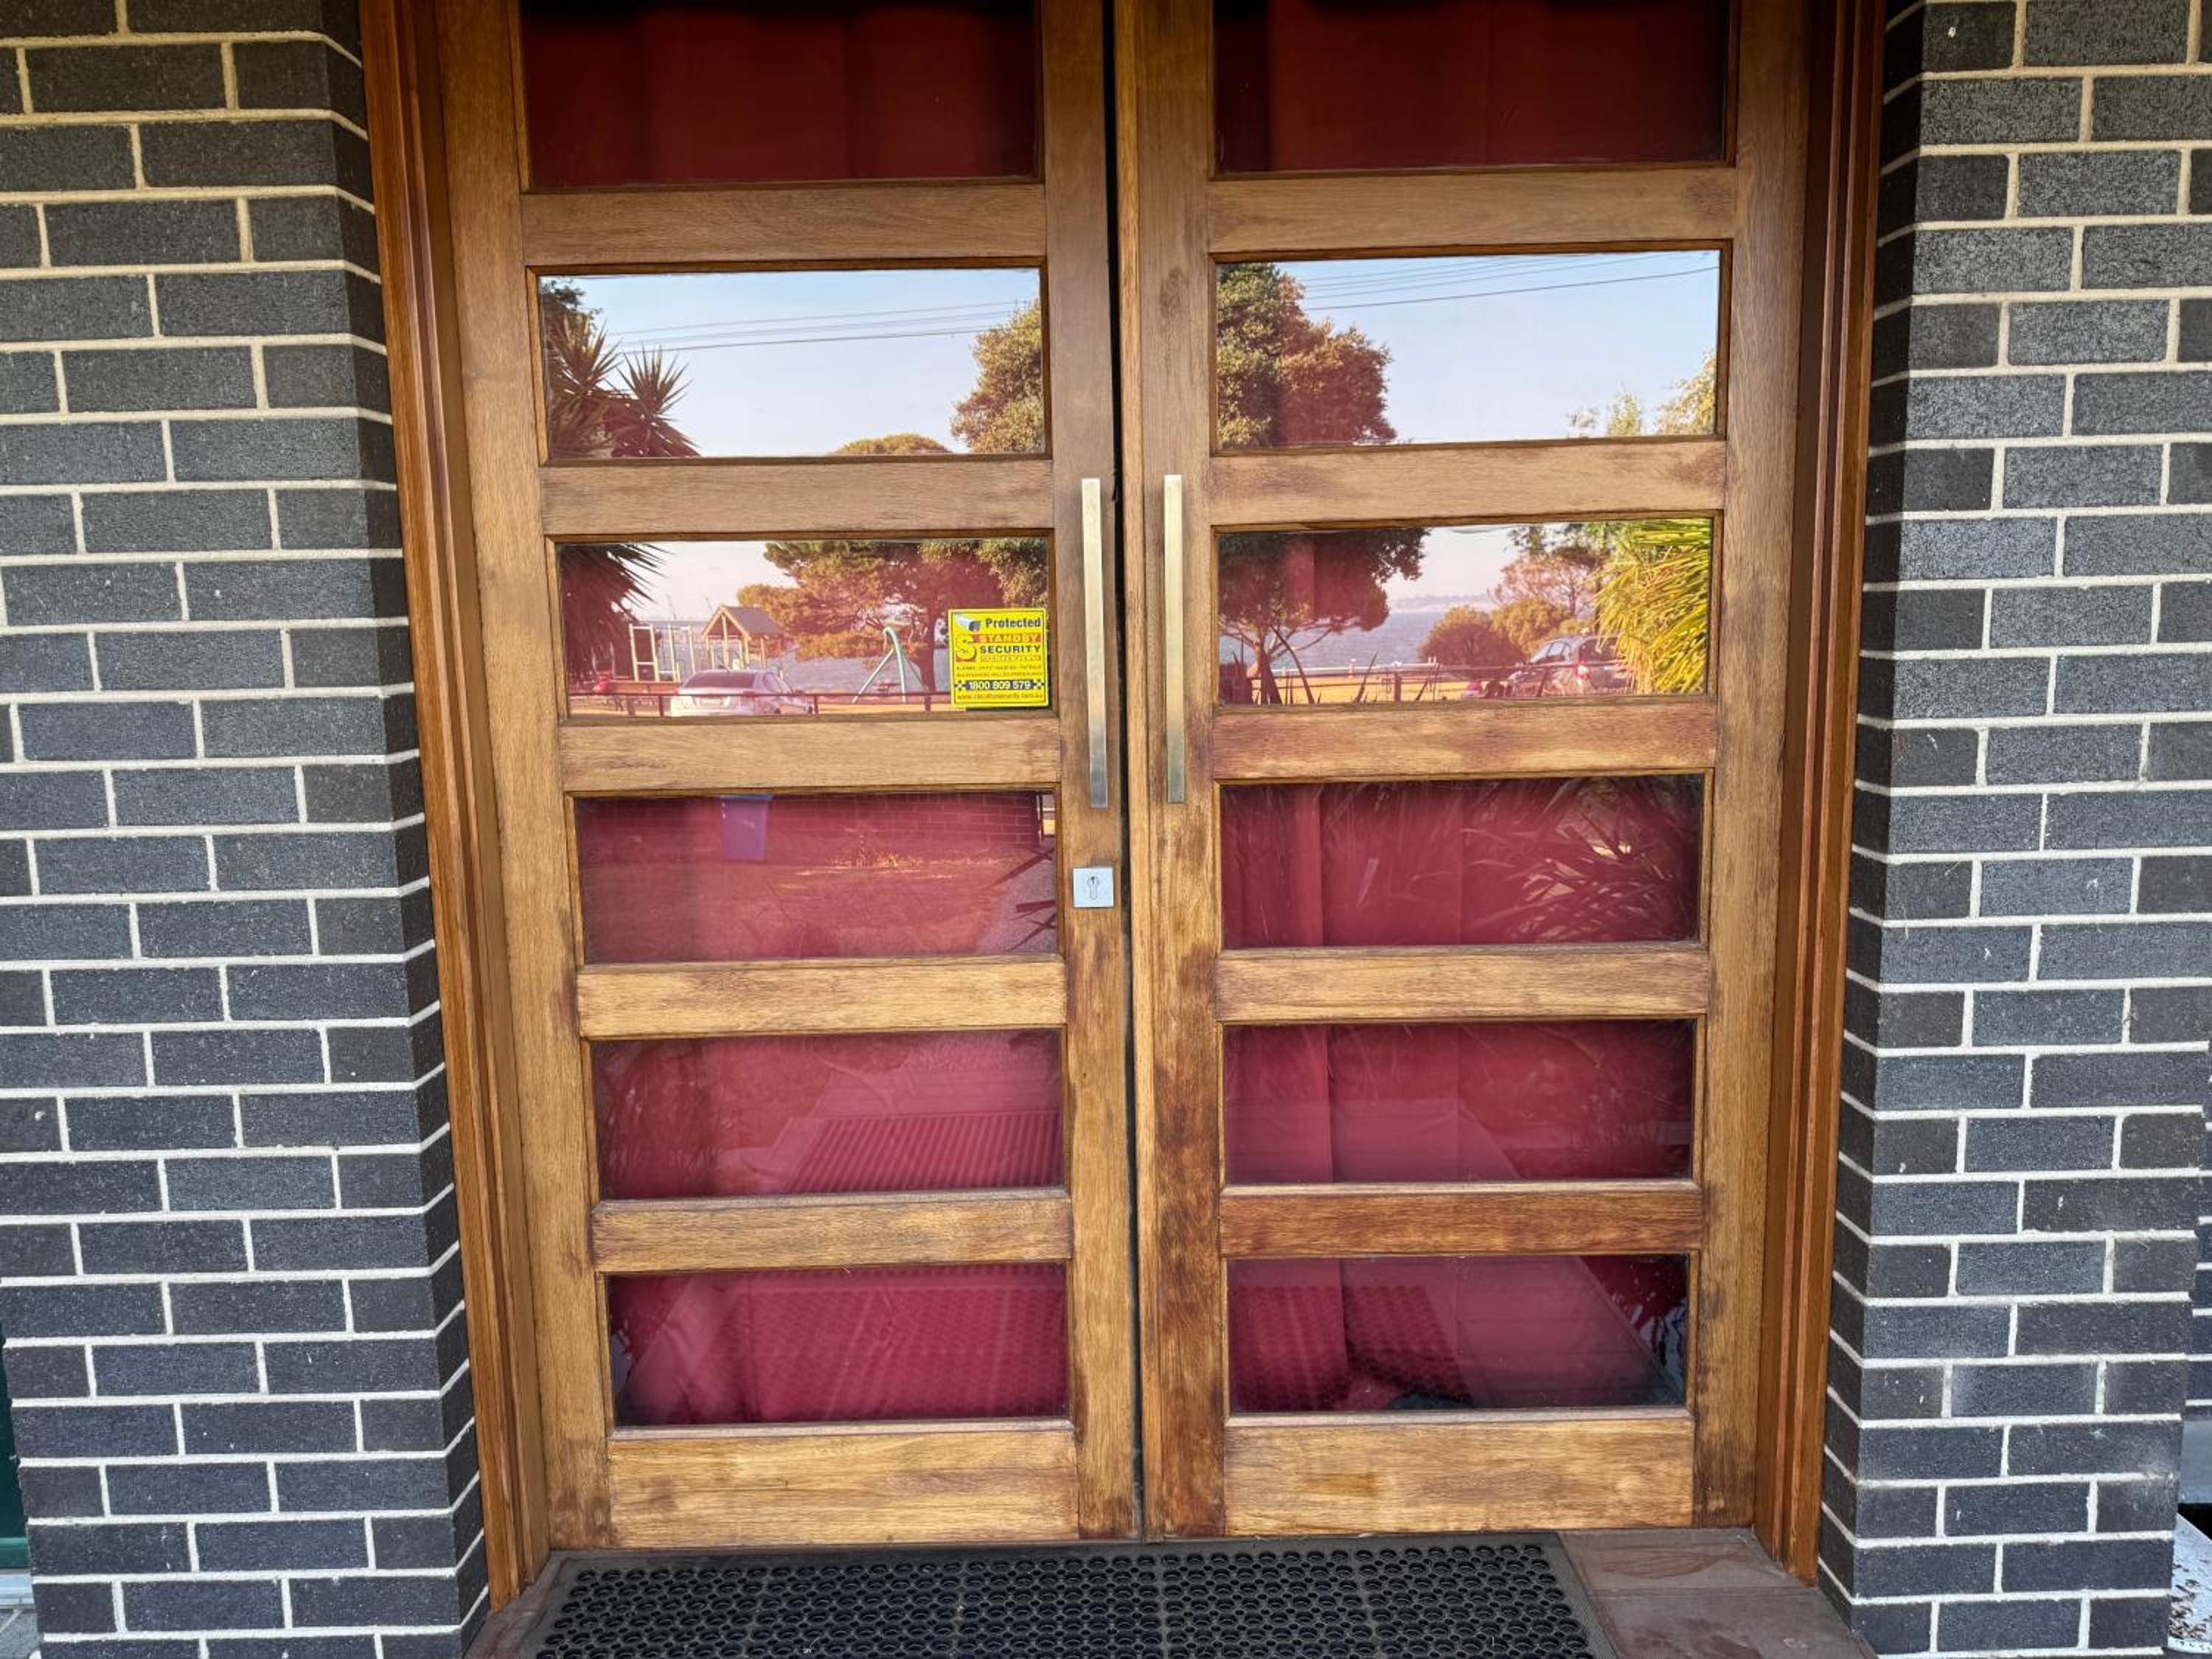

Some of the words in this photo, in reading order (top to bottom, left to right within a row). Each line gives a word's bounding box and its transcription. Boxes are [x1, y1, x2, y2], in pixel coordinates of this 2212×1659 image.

[986, 617, 1041, 627] Protected
[980, 634, 1037, 642] STANDBY
[980, 645, 1040, 653] SECURITY
[968, 681, 990, 689] 1800
